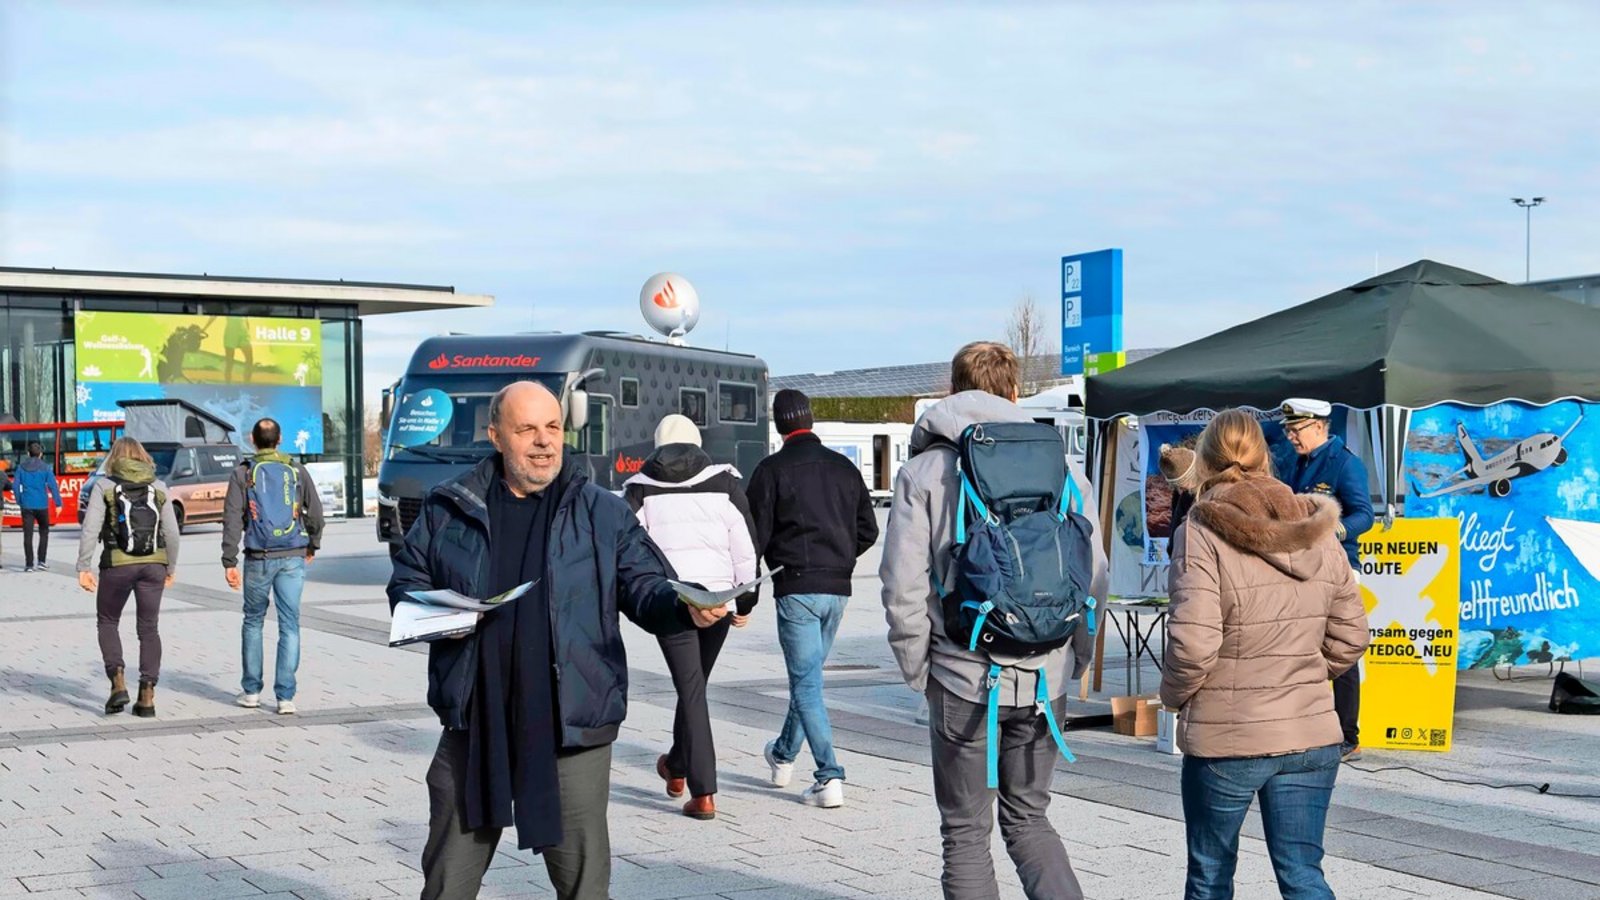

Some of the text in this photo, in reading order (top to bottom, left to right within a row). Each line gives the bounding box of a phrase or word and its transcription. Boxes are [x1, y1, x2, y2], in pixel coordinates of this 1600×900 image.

[1066, 265, 1074, 283] P
[1066, 301, 1074, 319] P
[255, 326, 311, 341] Halle 9
[450, 354, 541, 367] Santander
[56, 478, 86, 491] ART
[1387, 541, 1438, 555] NEUEN
[1360, 562, 1402, 575] OUTE
[1459, 569, 1579, 626] eltfreundlich
[1368, 628, 1453, 641] nsam gegen
